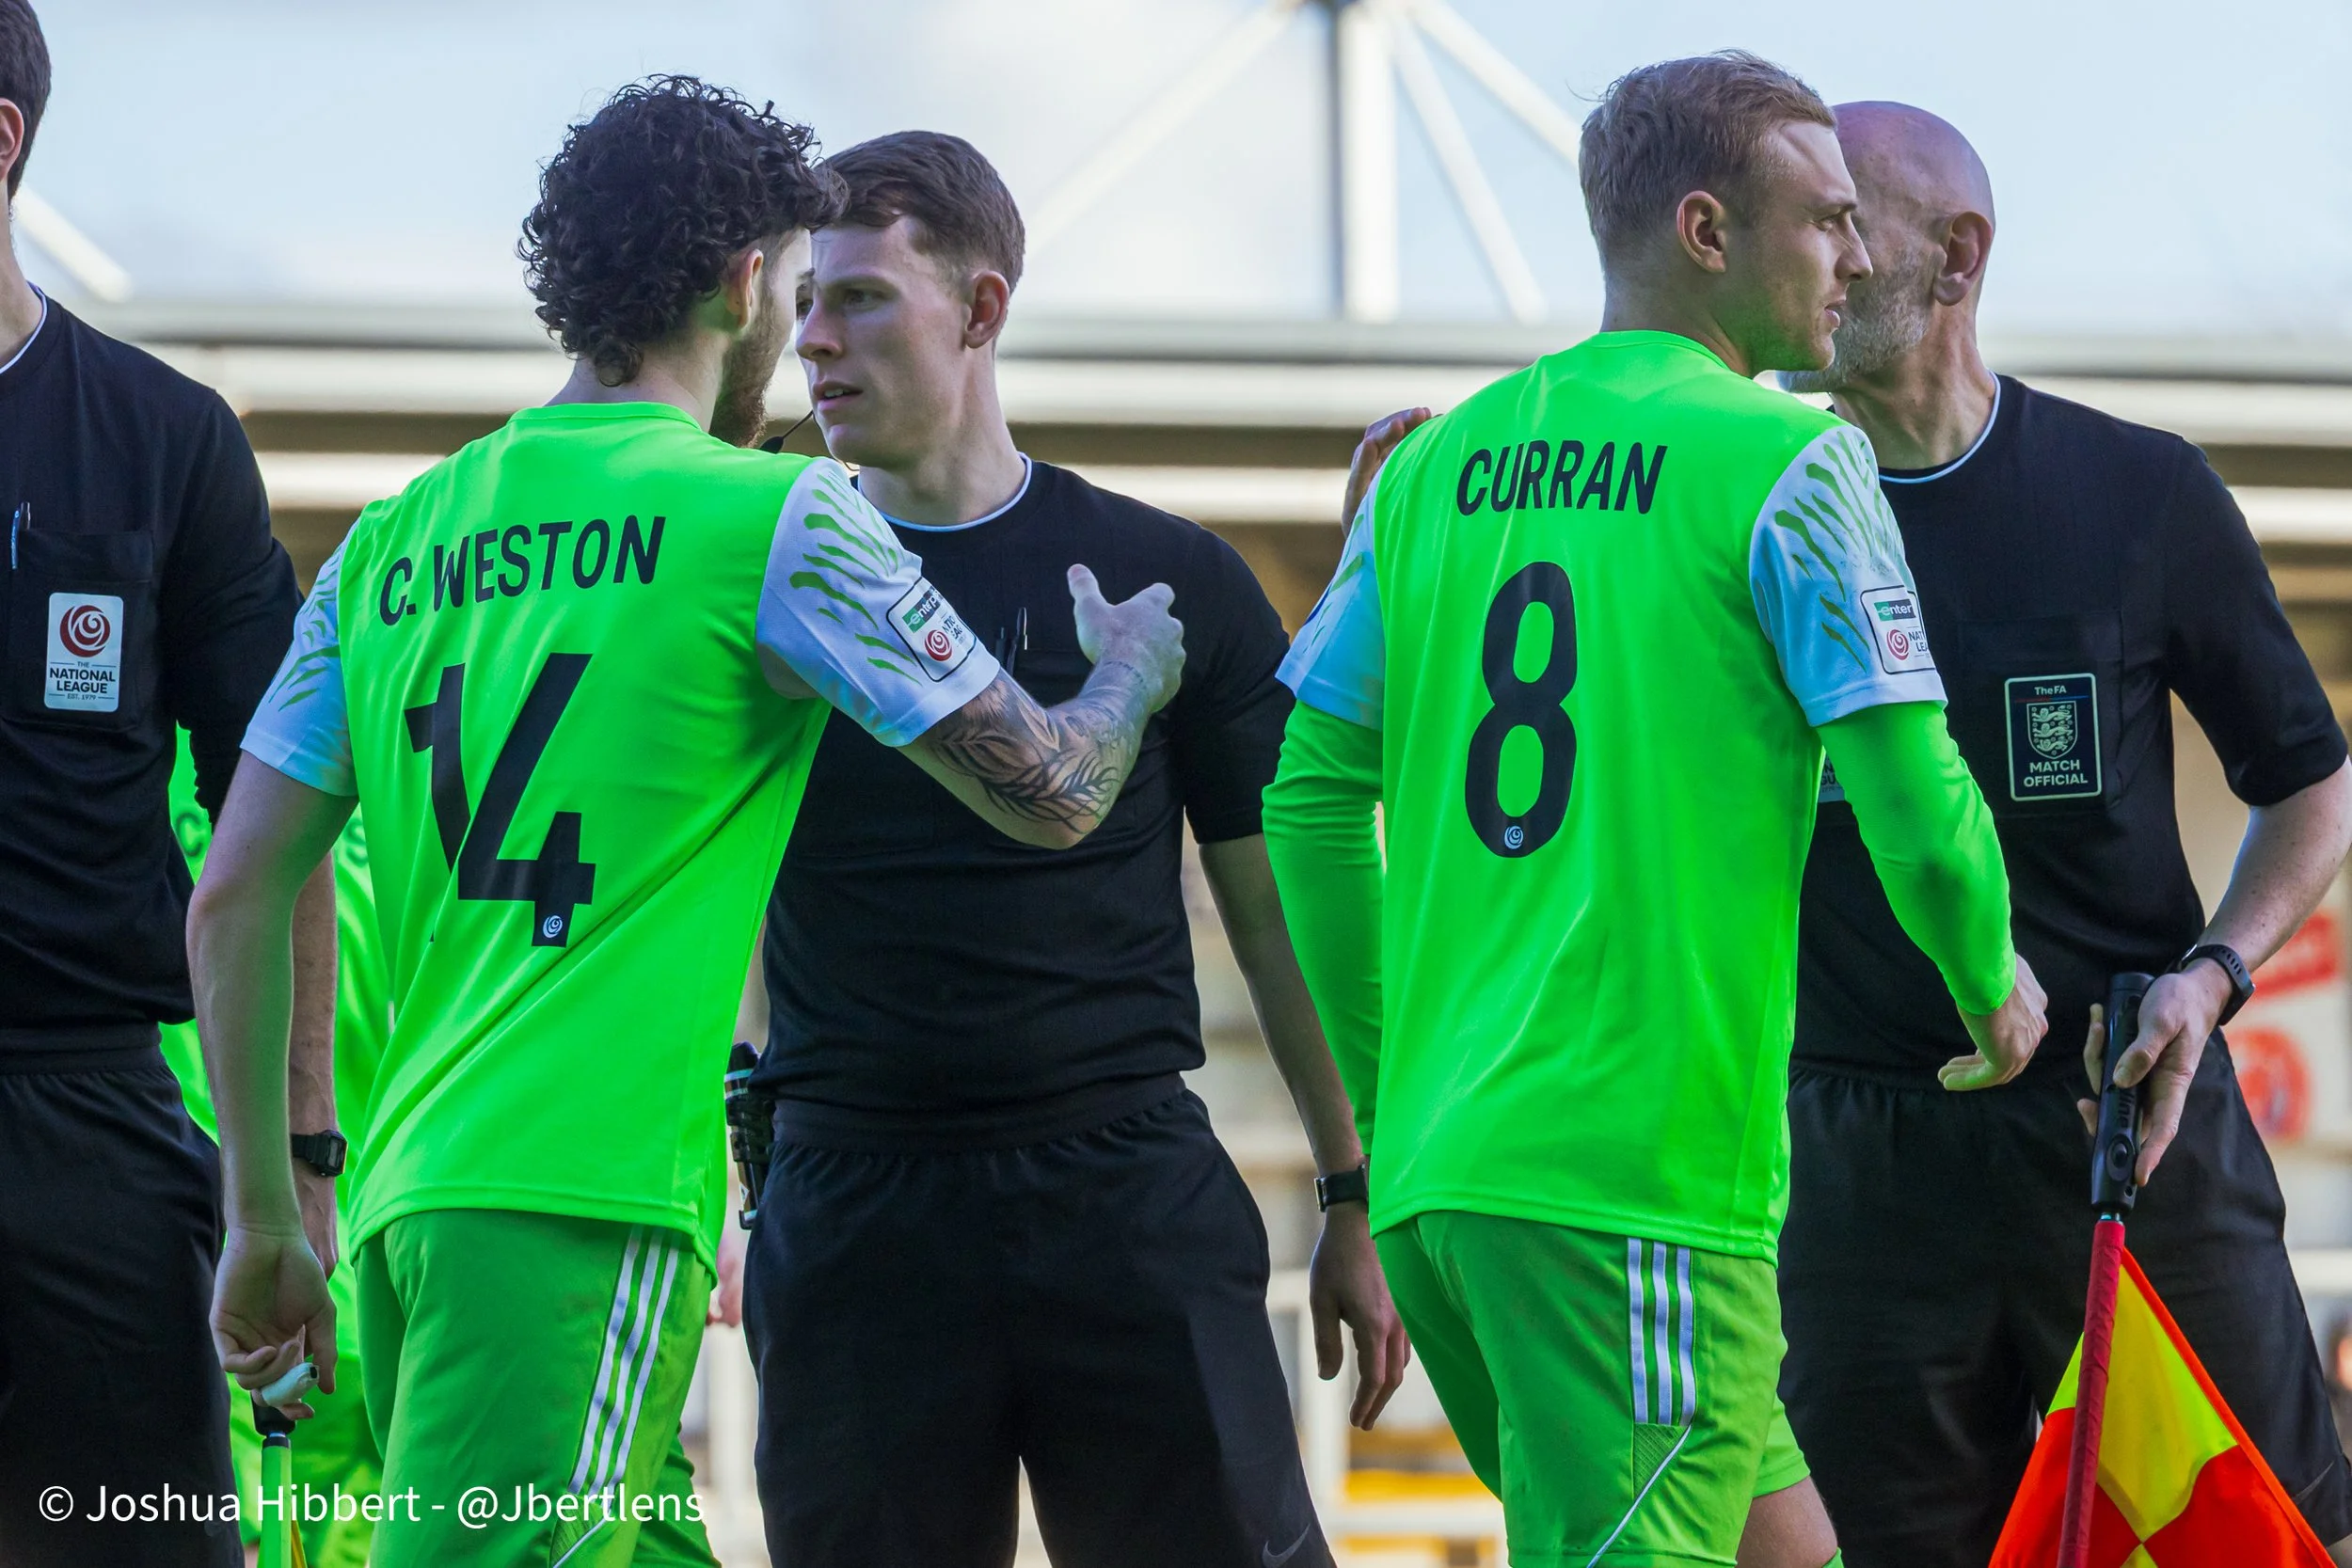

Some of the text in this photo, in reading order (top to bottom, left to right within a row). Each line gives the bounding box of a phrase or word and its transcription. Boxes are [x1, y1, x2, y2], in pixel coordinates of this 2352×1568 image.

[1455, 439, 1668, 516] CURRAN
[379, 515, 667, 626] C. WESTON
[50, 668, 116, 682] NATIONAL
[56, 680, 107, 693] LEAGUE
[1464, 561, 1578, 859] 8
[2024, 773, 2089, 787] OFFICIAL
[2029, 759, 2081, 773] MATCH
[404, 652, 596, 948] 14
